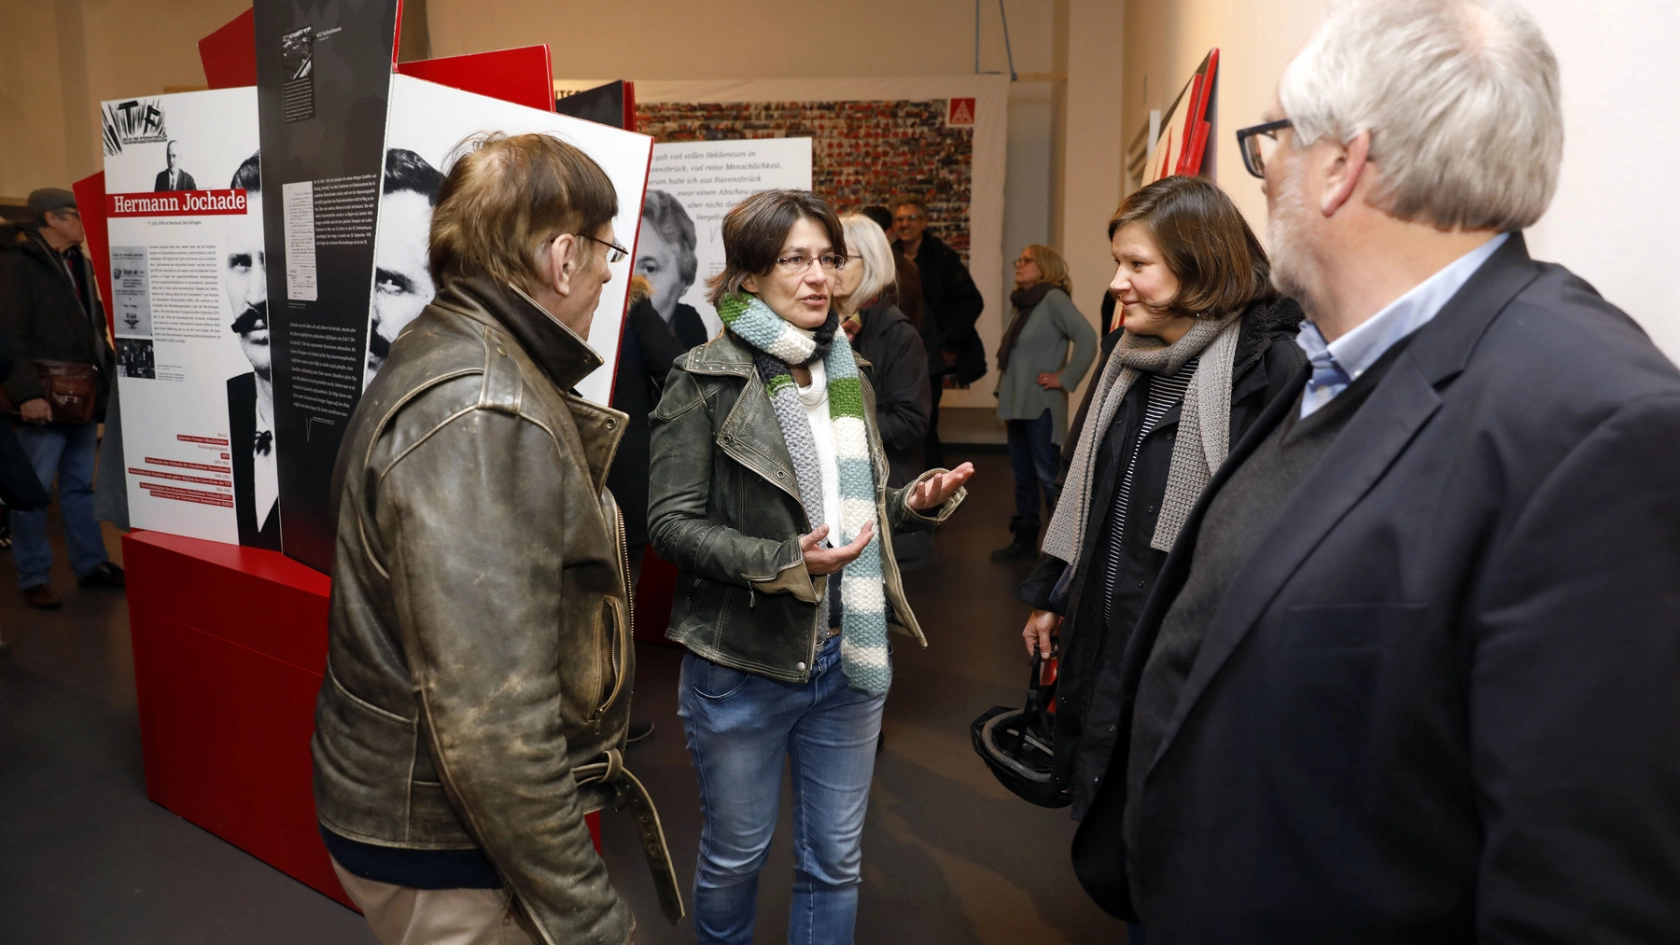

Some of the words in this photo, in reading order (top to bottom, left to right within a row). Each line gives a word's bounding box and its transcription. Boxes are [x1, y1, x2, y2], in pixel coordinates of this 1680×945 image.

[706, 150, 746, 158] Heldentum
[114, 196, 180, 212] Hermann
[183, 190, 246, 211] Jochade
[705, 200, 724, 208] nicht
